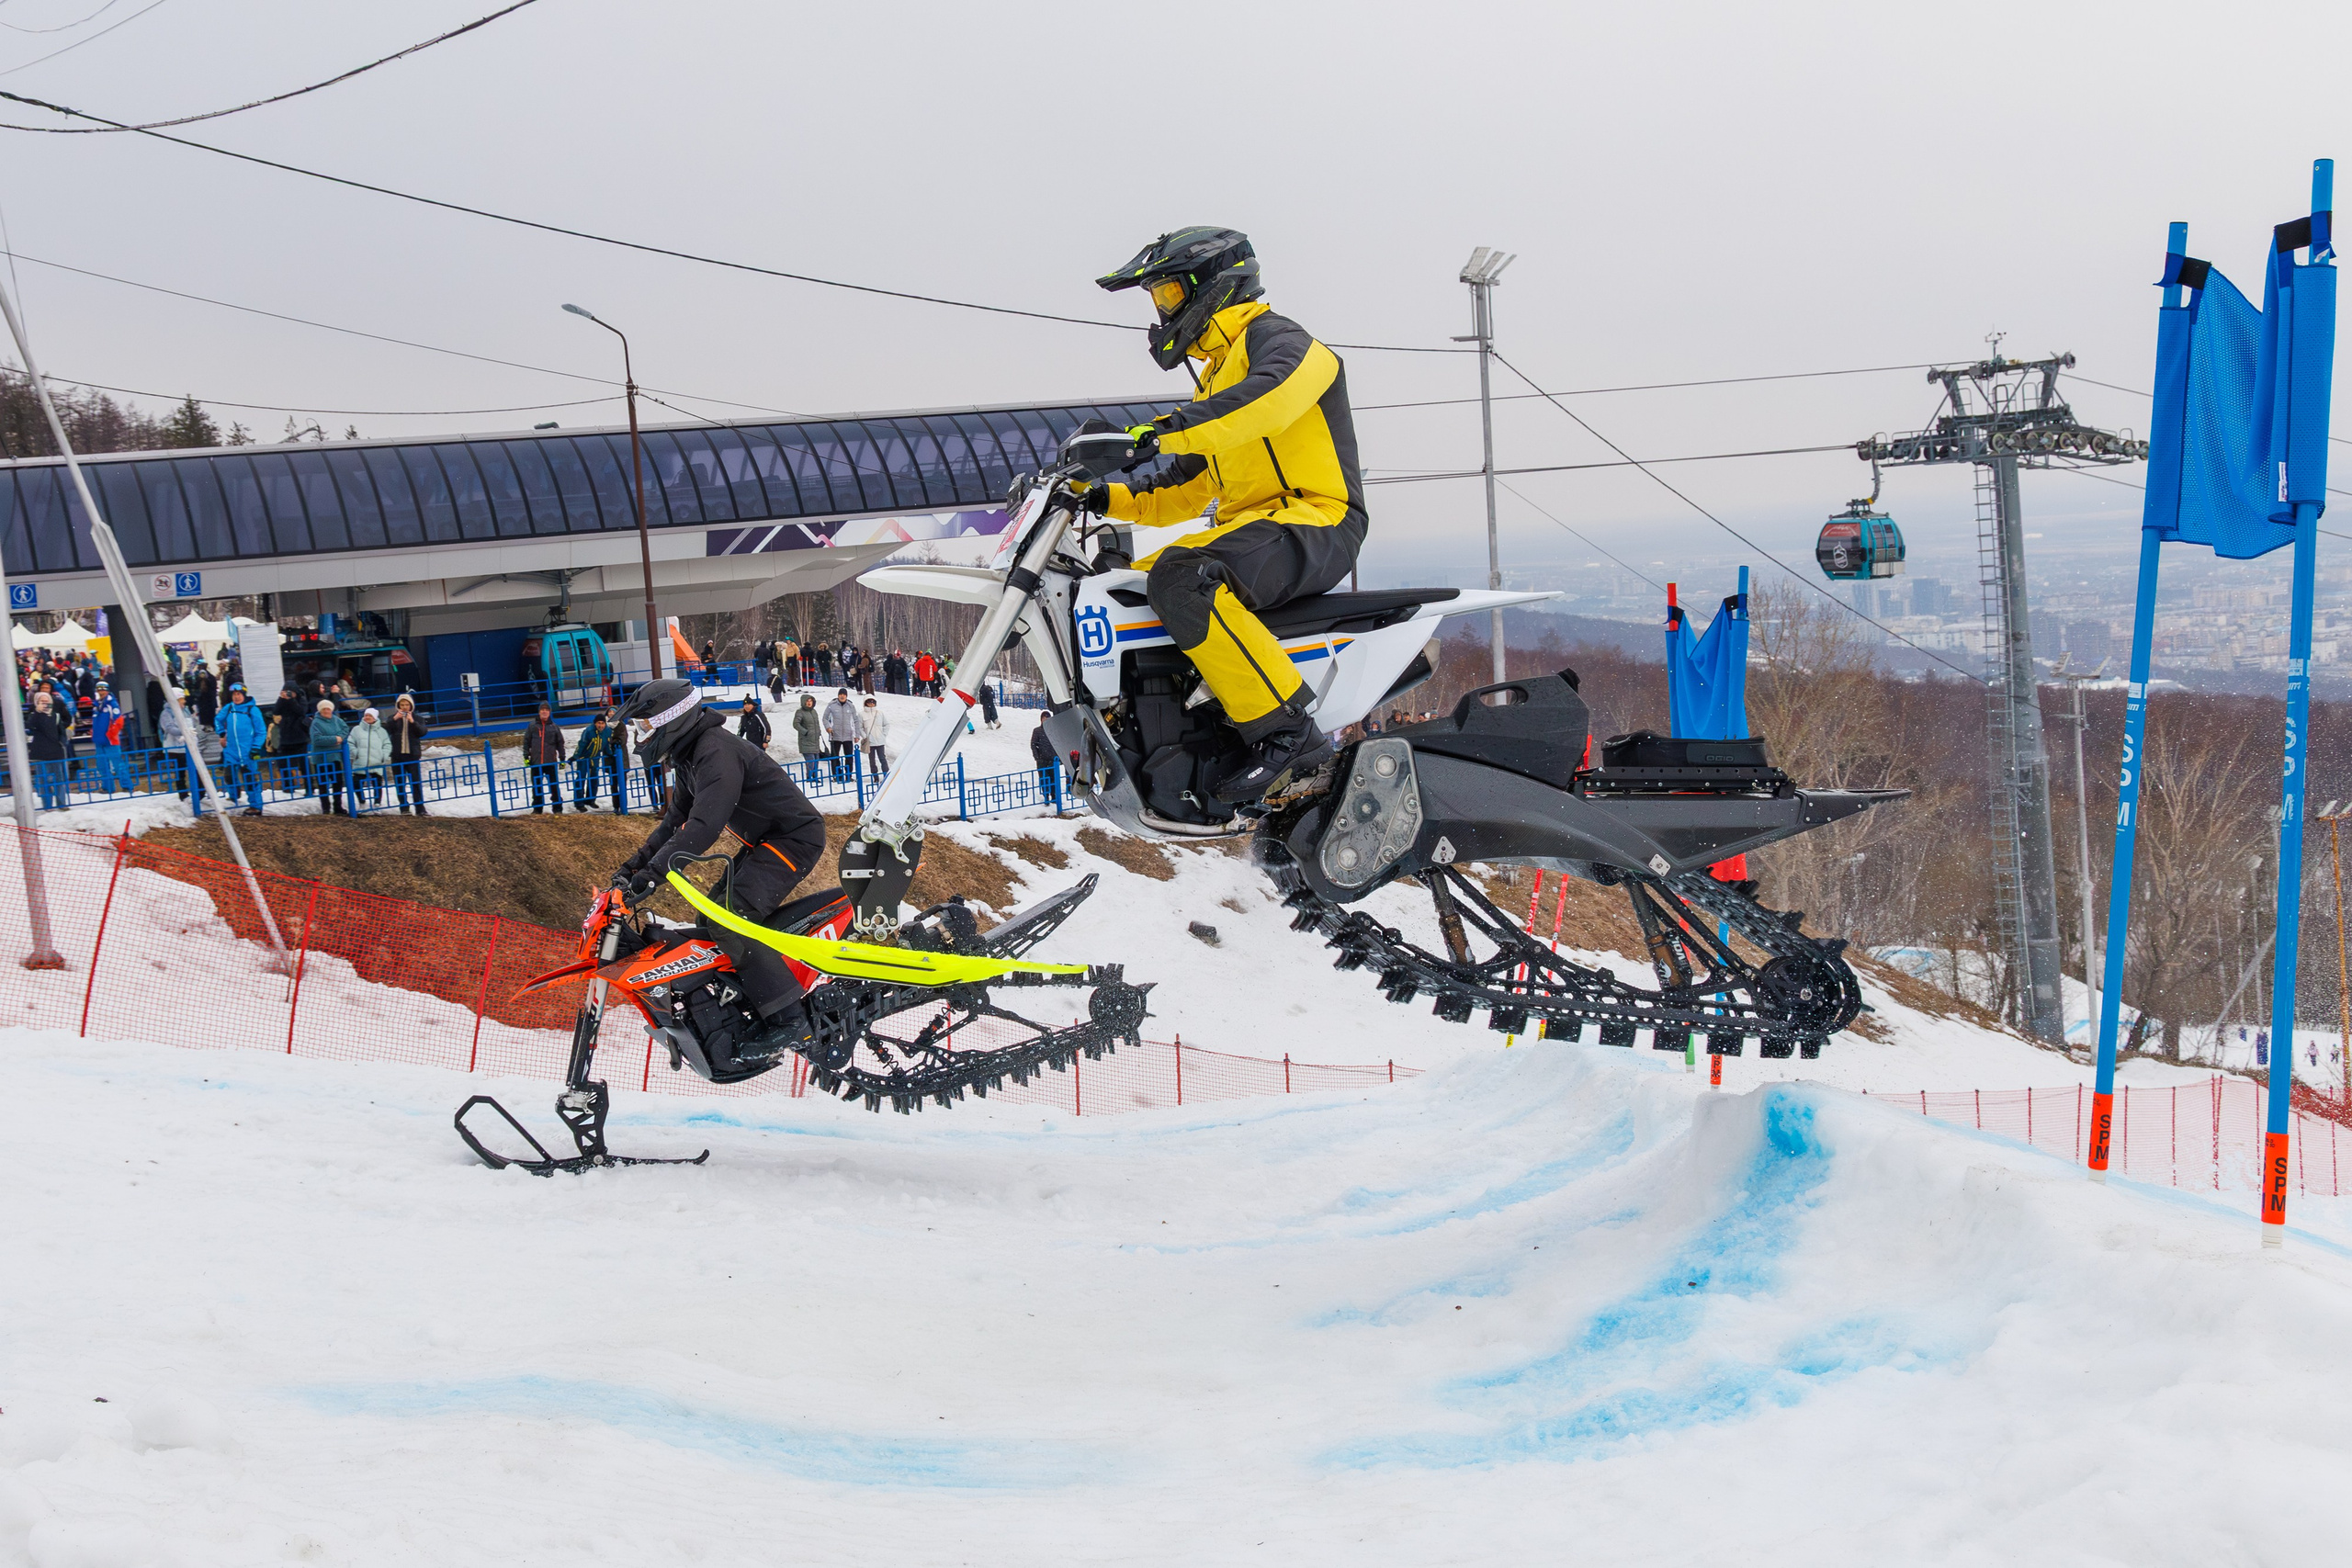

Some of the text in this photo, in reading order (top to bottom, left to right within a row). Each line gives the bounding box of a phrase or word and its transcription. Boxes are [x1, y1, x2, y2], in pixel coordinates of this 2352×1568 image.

[1083, 659, 1115, 668] Husqvarna
[645, 964, 698, 983] ENDURO
[2096, 1113, 2111, 1160] SPM
[2270, 1156, 2288, 1213] SPM
